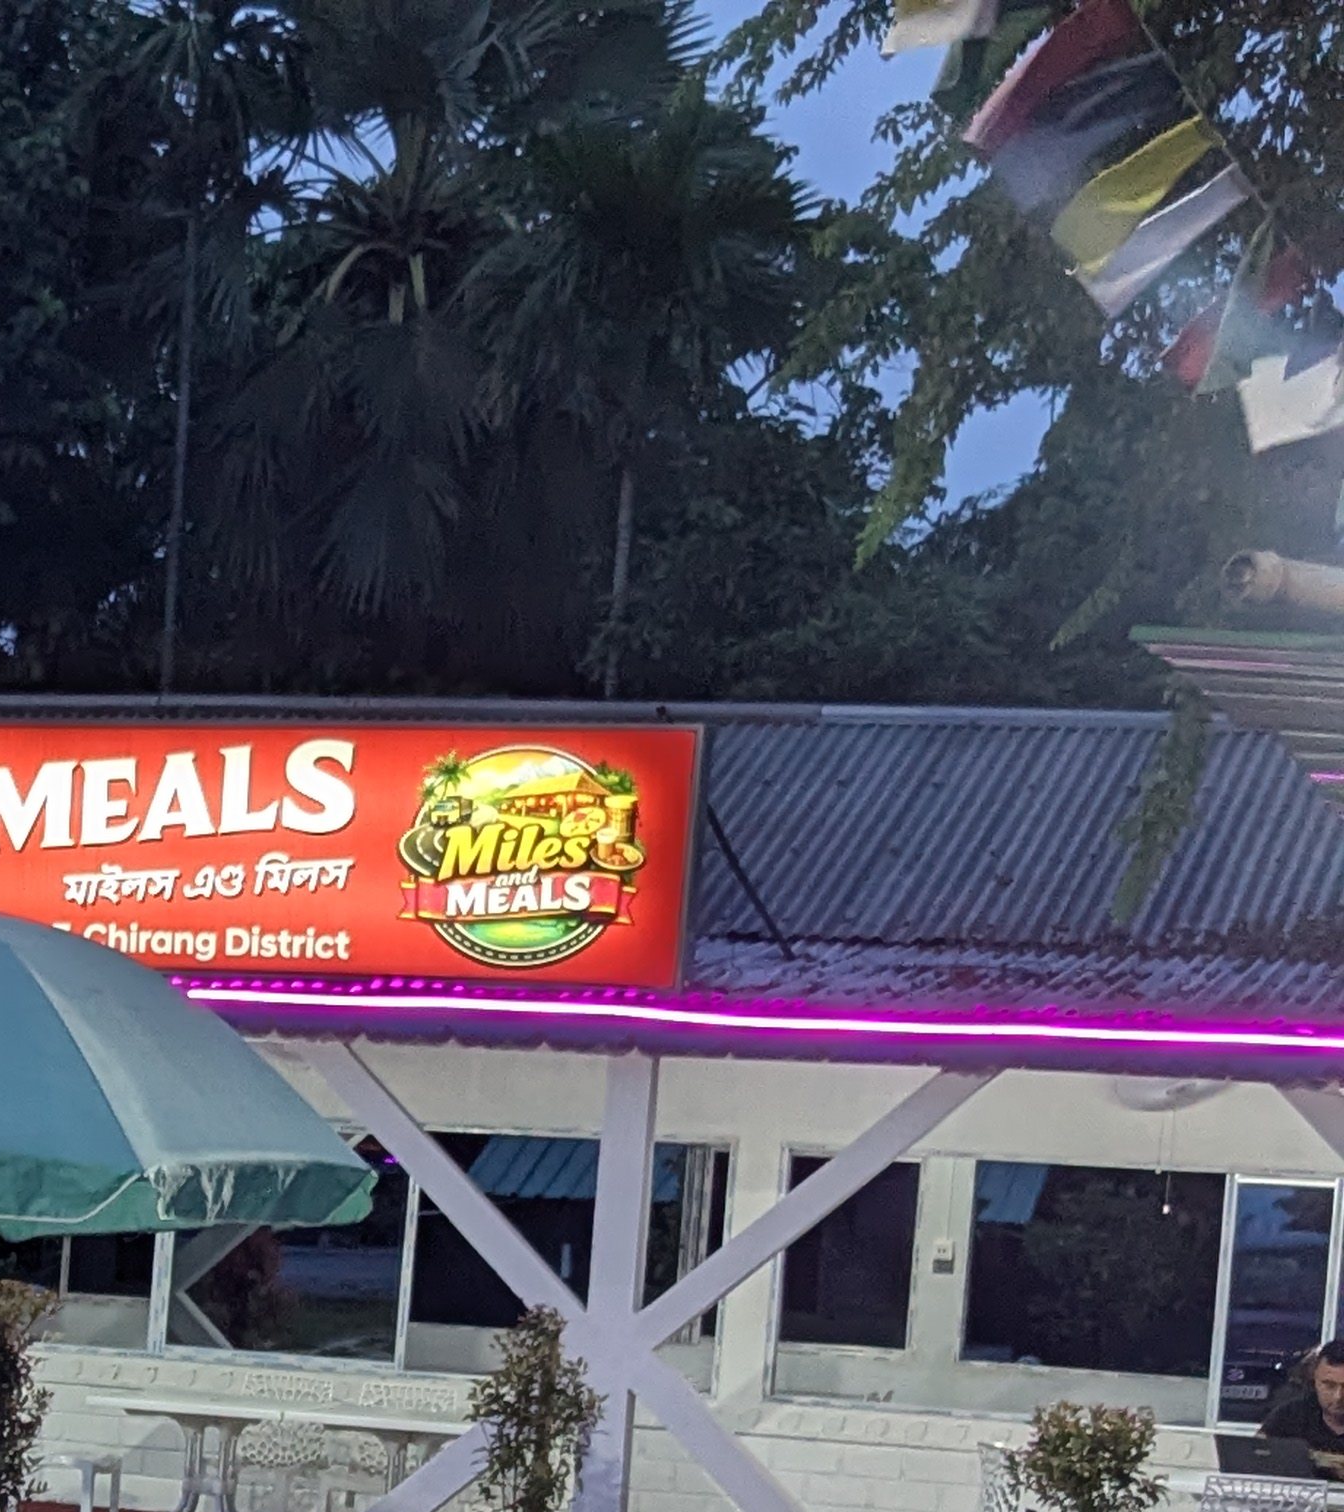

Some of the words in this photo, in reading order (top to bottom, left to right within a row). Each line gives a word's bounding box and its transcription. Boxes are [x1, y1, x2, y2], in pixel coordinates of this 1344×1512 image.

[437, 823, 591, 882] Miles
[494, 864, 539, 887] and
[445, 874, 592, 917] MEALS
[224, 925, 351, 960] District
